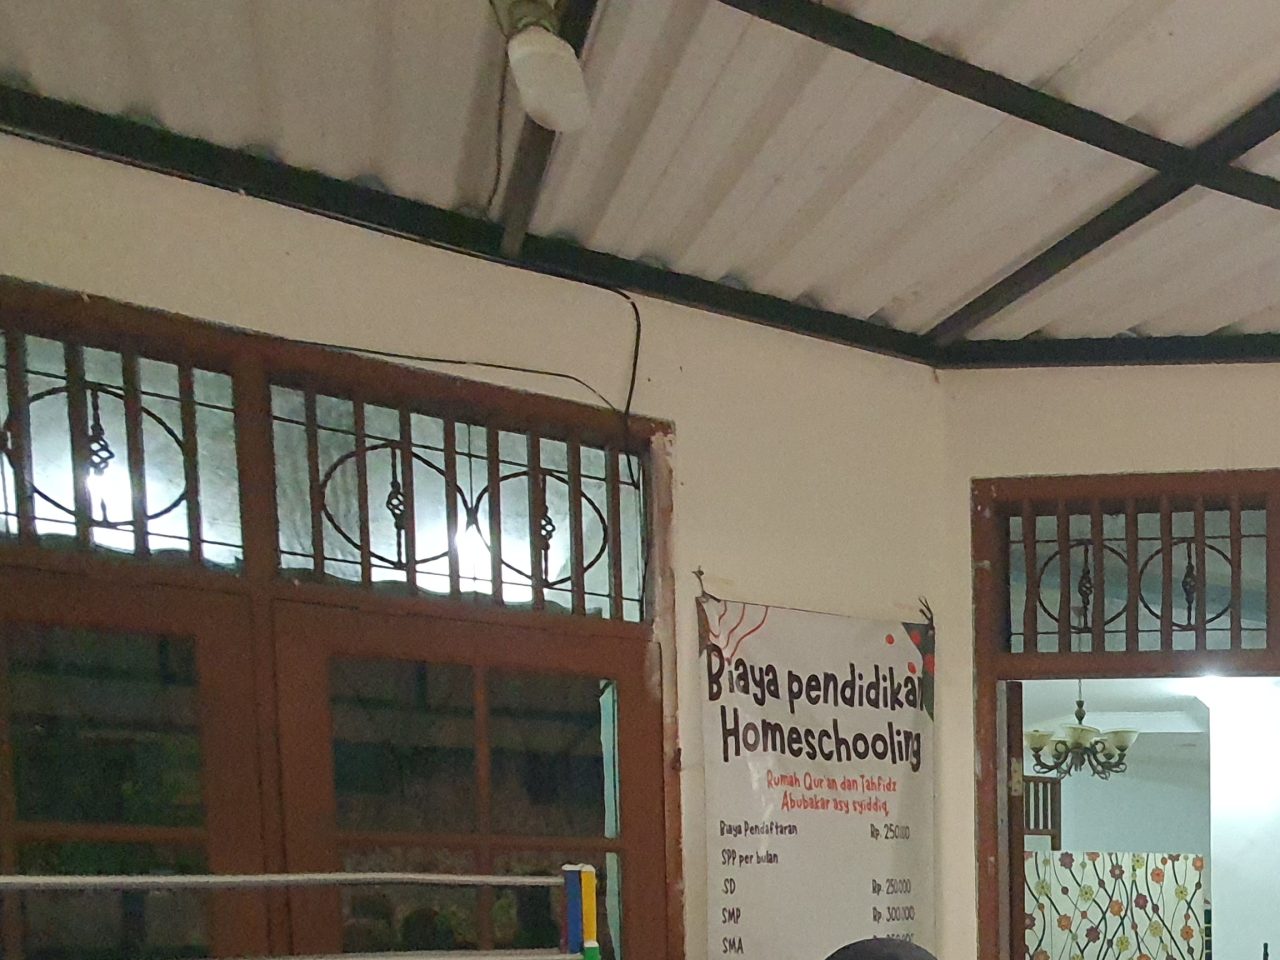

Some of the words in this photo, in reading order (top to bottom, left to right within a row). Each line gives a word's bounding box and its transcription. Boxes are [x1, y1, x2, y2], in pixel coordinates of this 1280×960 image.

[706, 643, 781, 706] Biaya
[720, 705, 921, 772] Homeschooling
[766, 769, 800, 789] Rumah
[840, 776, 858, 791] dan
[781, 790, 831, 812] Abubakar
[719, 820, 742, 837] Biaya
[744, 820, 798, 837] Pendaftaran
[721, 848, 737, 865] SPP
[739, 853, 754, 868] per
[756, 850, 779, 864] bulan
[722, 878, 736, 895] SD
[721, 907, 741, 925] SMP
[722, 937, 744, 954] SMA
